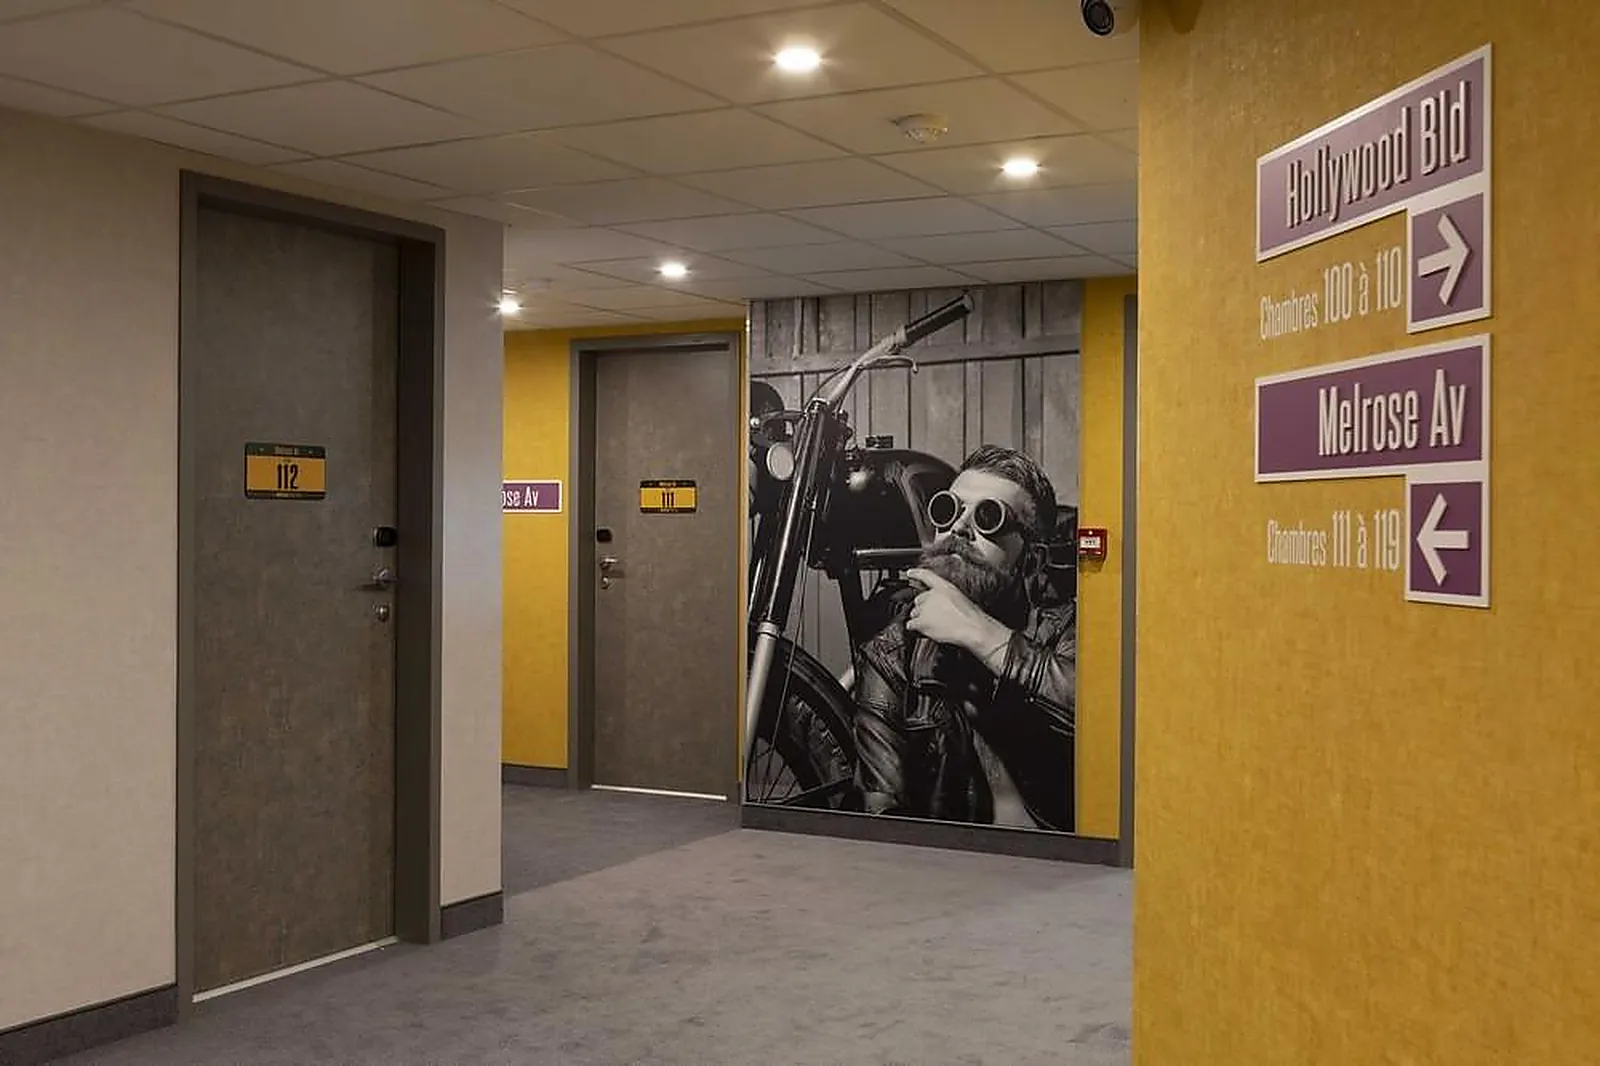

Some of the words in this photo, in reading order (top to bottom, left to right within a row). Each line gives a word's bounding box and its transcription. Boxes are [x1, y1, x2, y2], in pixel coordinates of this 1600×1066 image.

[1287, 106, 1411, 229] Hollywood
[1420, 80, 1469, 175] Bld
[1260, 290, 1319, 340] Chambres
[1324, 262, 1352, 324] 100
[1358, 262, 1369, 316] à
[1376, 246, 1402, 310] 110
[1318, 383, 1418, 456] Melrose
[1429, 368, 1466, 447] Av
[277, 463, 299, 489] 112
[524, 486, 539, 507] Av
[661, 491, 675, 507] 111
[1267, 520, 1327, 566] Chambres
[1331, 510, 1351, 568] 111
[1357, 514, 1367, 569] à
[1373, 510, 1401, 571] 119
